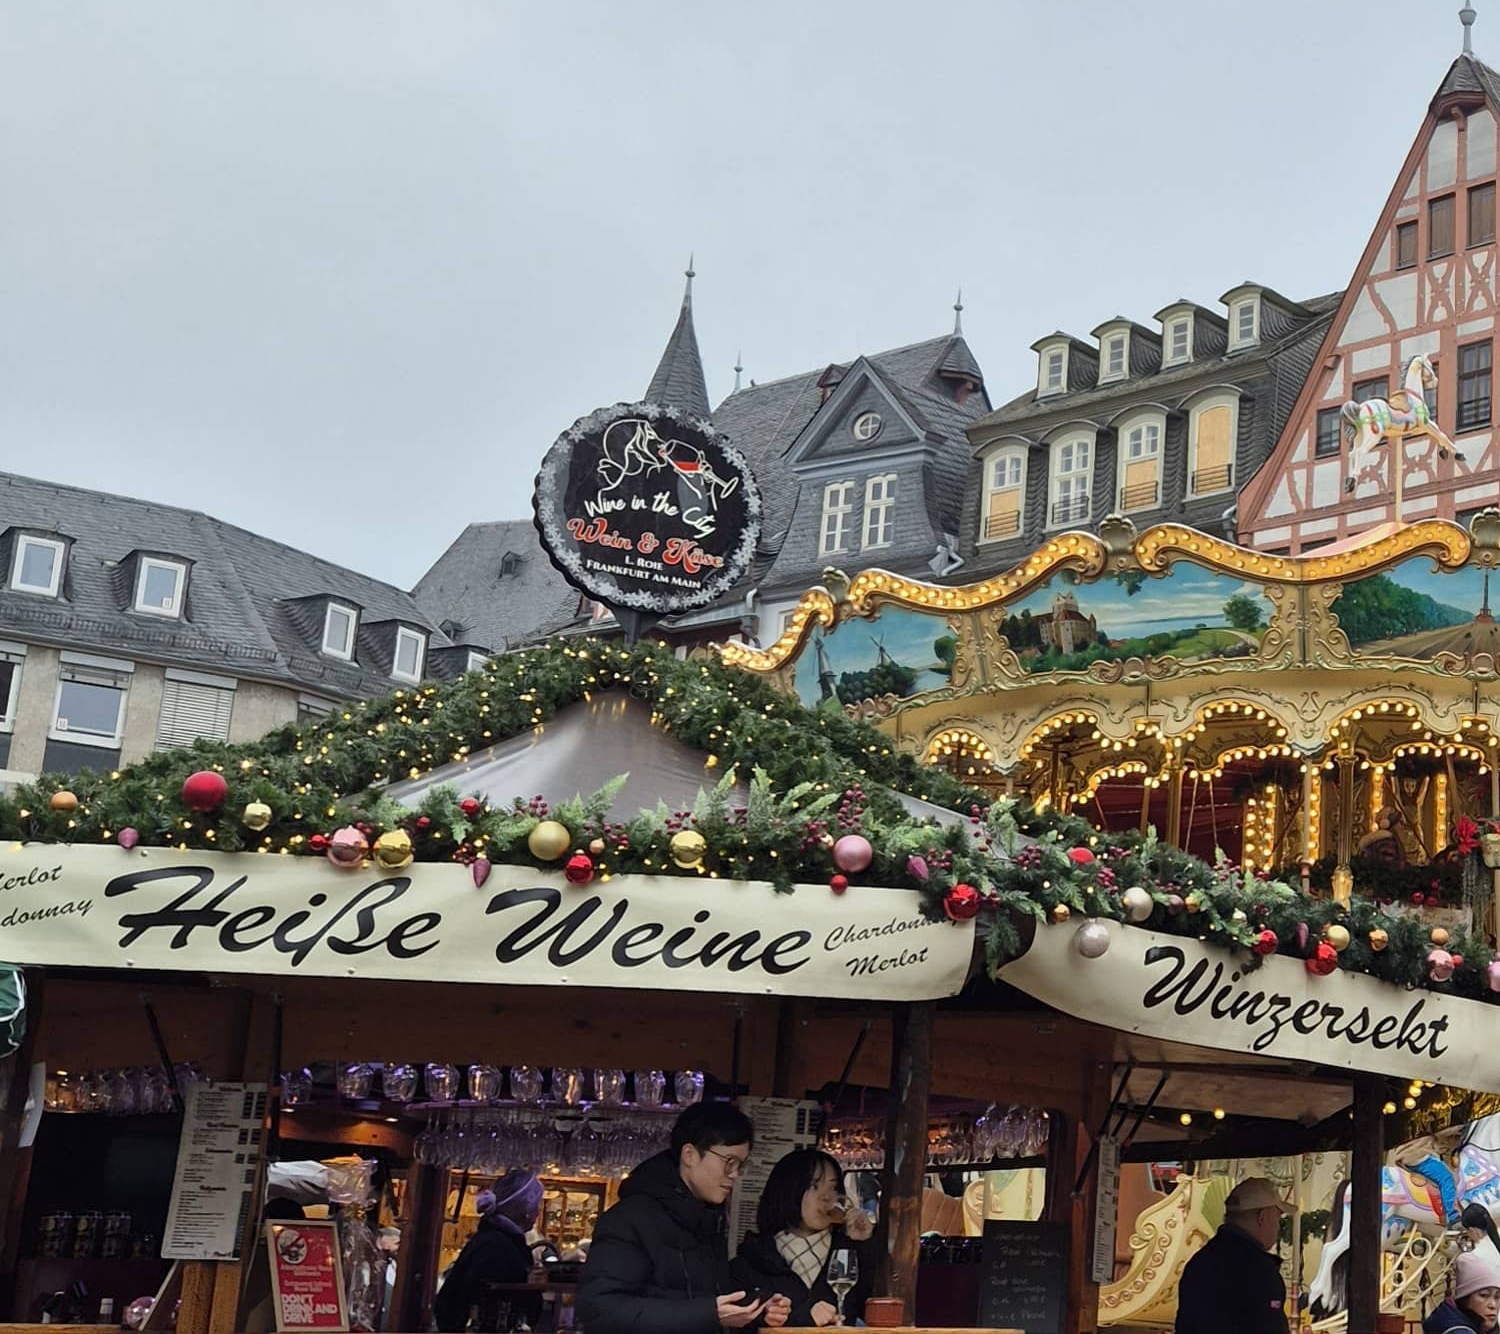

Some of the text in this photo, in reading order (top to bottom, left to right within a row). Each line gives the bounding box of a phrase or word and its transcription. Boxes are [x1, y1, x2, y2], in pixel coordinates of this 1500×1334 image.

[584, 491, 716, 539] Wine in the City
[567, 517, 725, 574] Wein & Käse
[586, 559, 649, 579] FRANKFURT
[671, 577, 701, 589] MAIN
[0, 865, 62, 891] erlot
[0, 899, 93, 927] donnay
[105, 865, 812, 975] Heiße Weine
[824, 916, 957, 952] Chardonn
[845, 947, 929, 977] Merlot
[1143, 945, 1449, 1059] Winzersekt
[283, 1314, 314, 1324] DRIVE
[314, 1303, 338, 1314] AND
